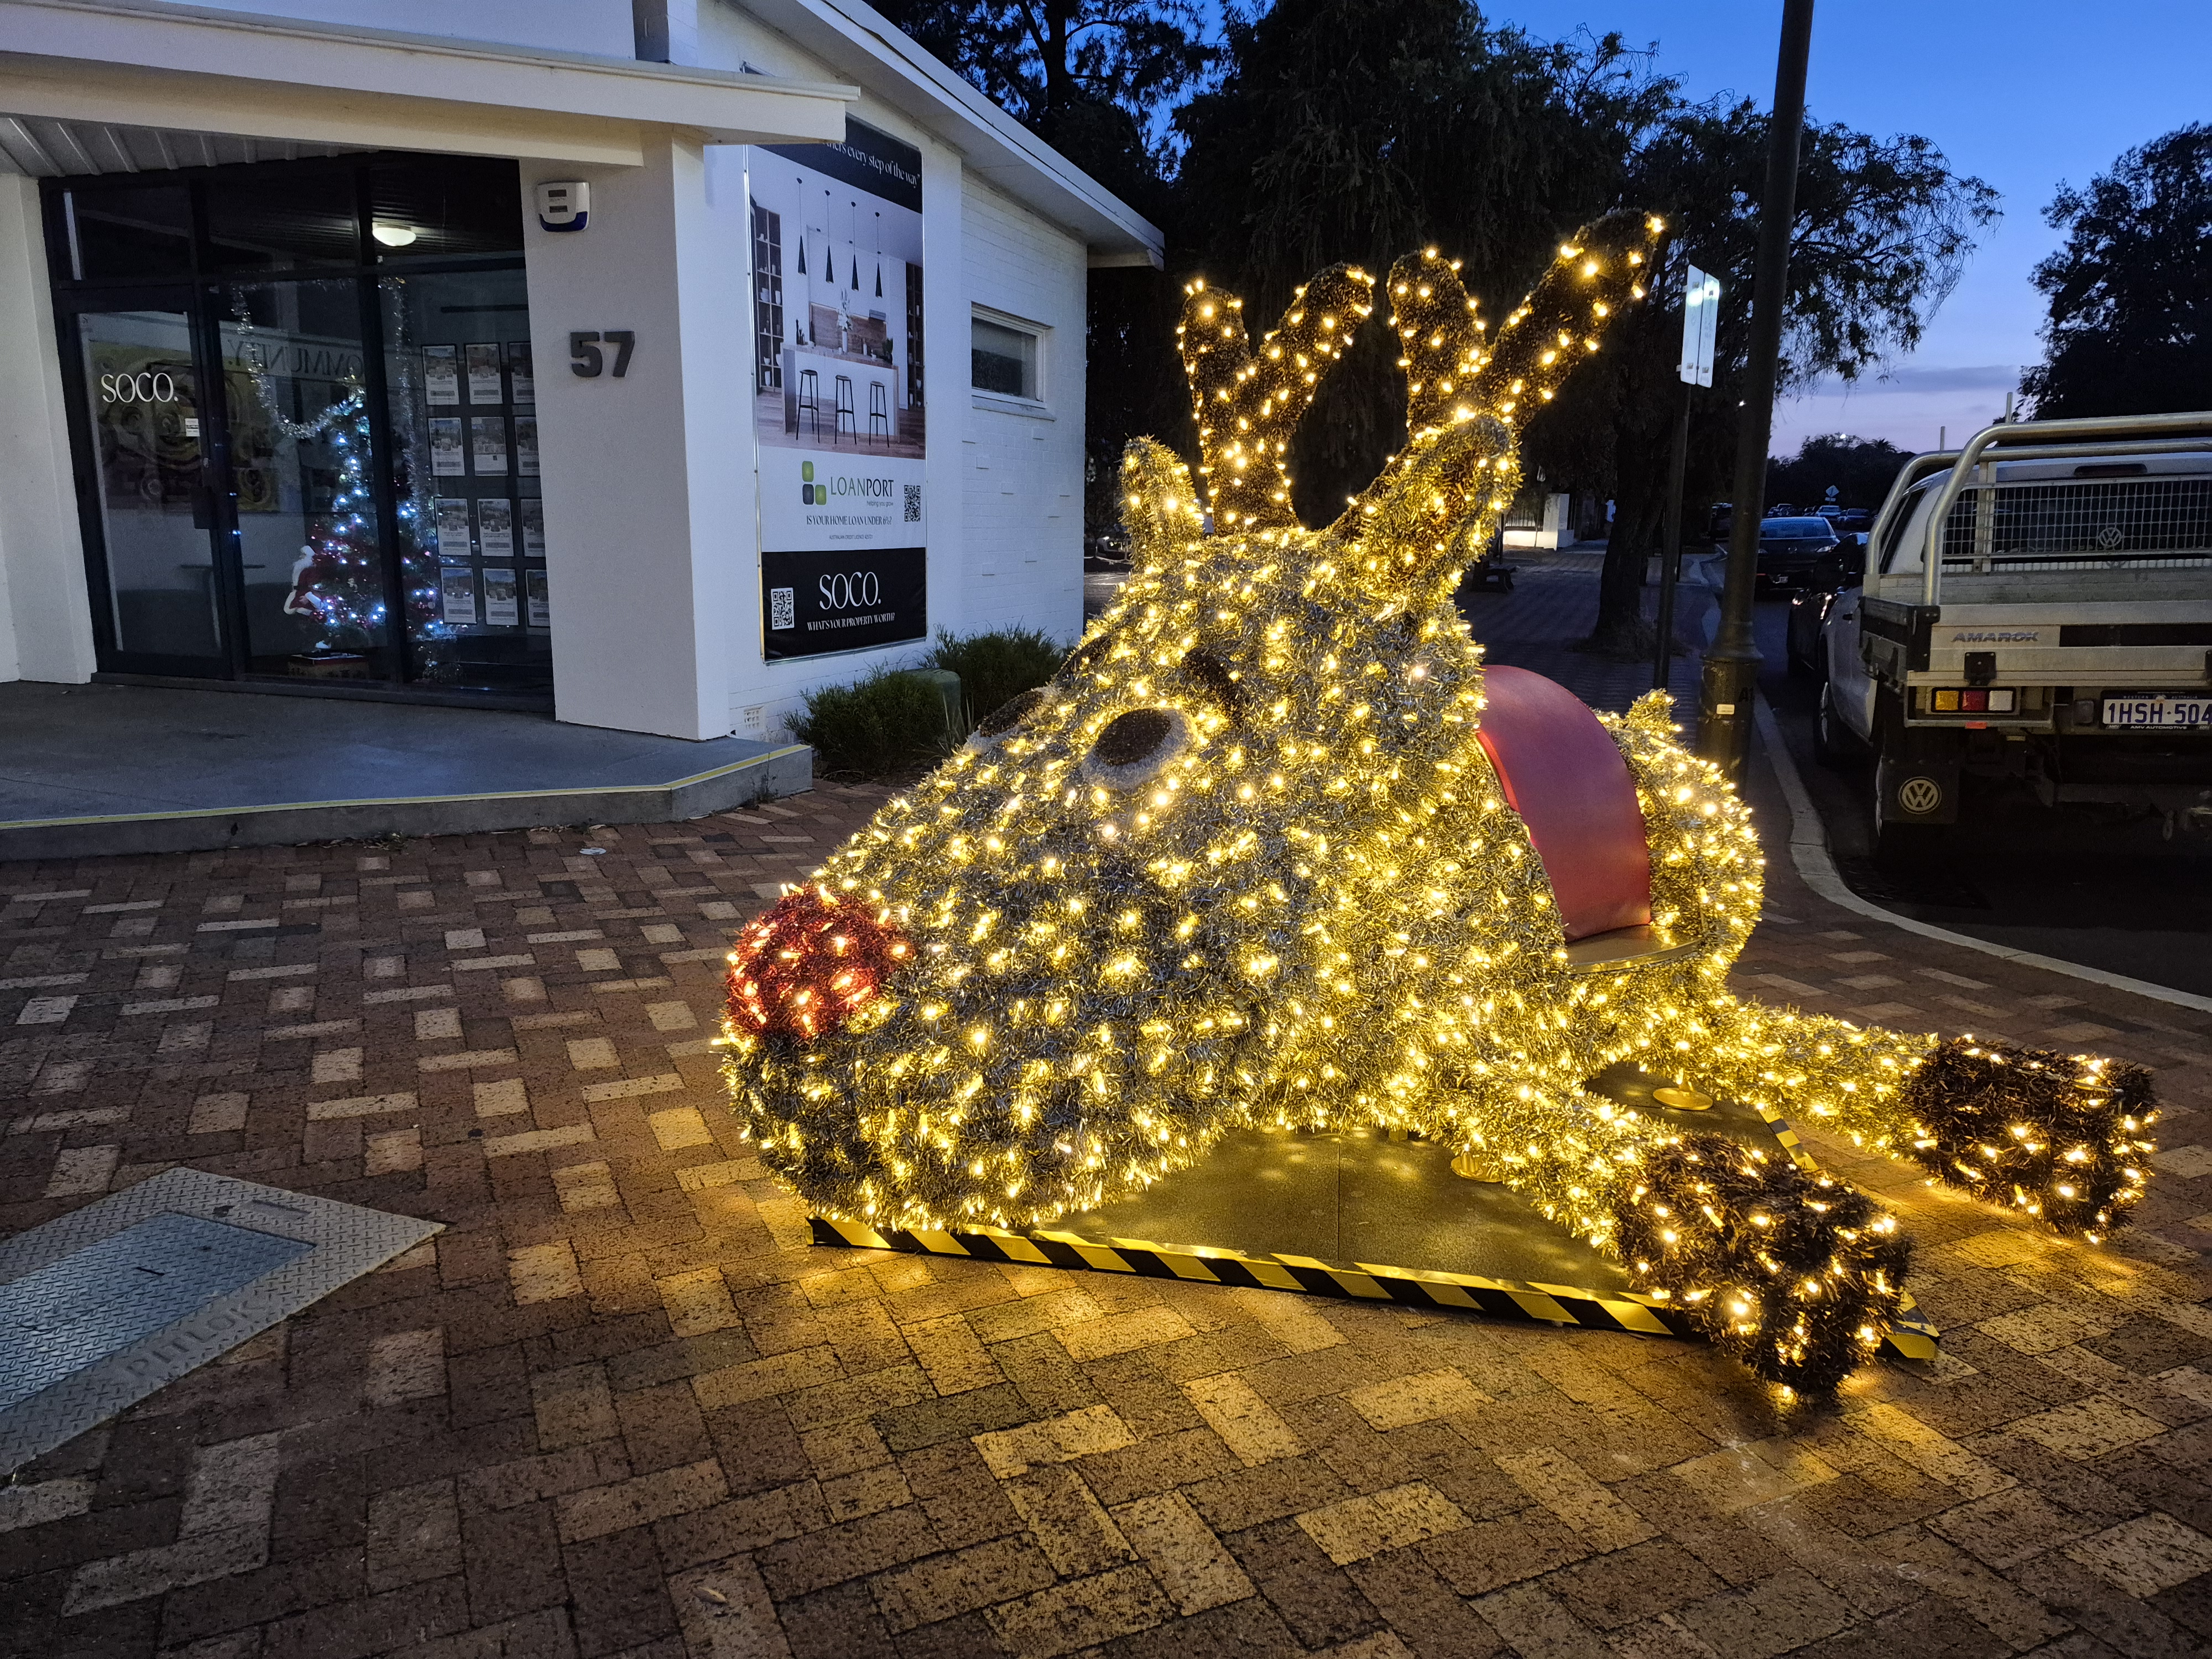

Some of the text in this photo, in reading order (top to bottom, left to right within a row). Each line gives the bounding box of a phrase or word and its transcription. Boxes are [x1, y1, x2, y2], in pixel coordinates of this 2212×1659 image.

[848, 146, 867, 166] every
[869, 155, 884, 174] step
[885, 160, 893, 174] of
[894, 163, 905, 180] the
[570, 331, 635, 377] 57
[101, 372, 179, 403] SOCO.
[831, 476, 894, 497] LOANPORT
[806, 515, 892, 525] IS YOUR HOME LOAN UNDER 6%?
[819, 571, 881, 610] SOCO.
[807, 612, 895, 631] WHAT'S YOUR PROPERTY WORTH?
[1951, 632, 2039, 642] AMAROK
